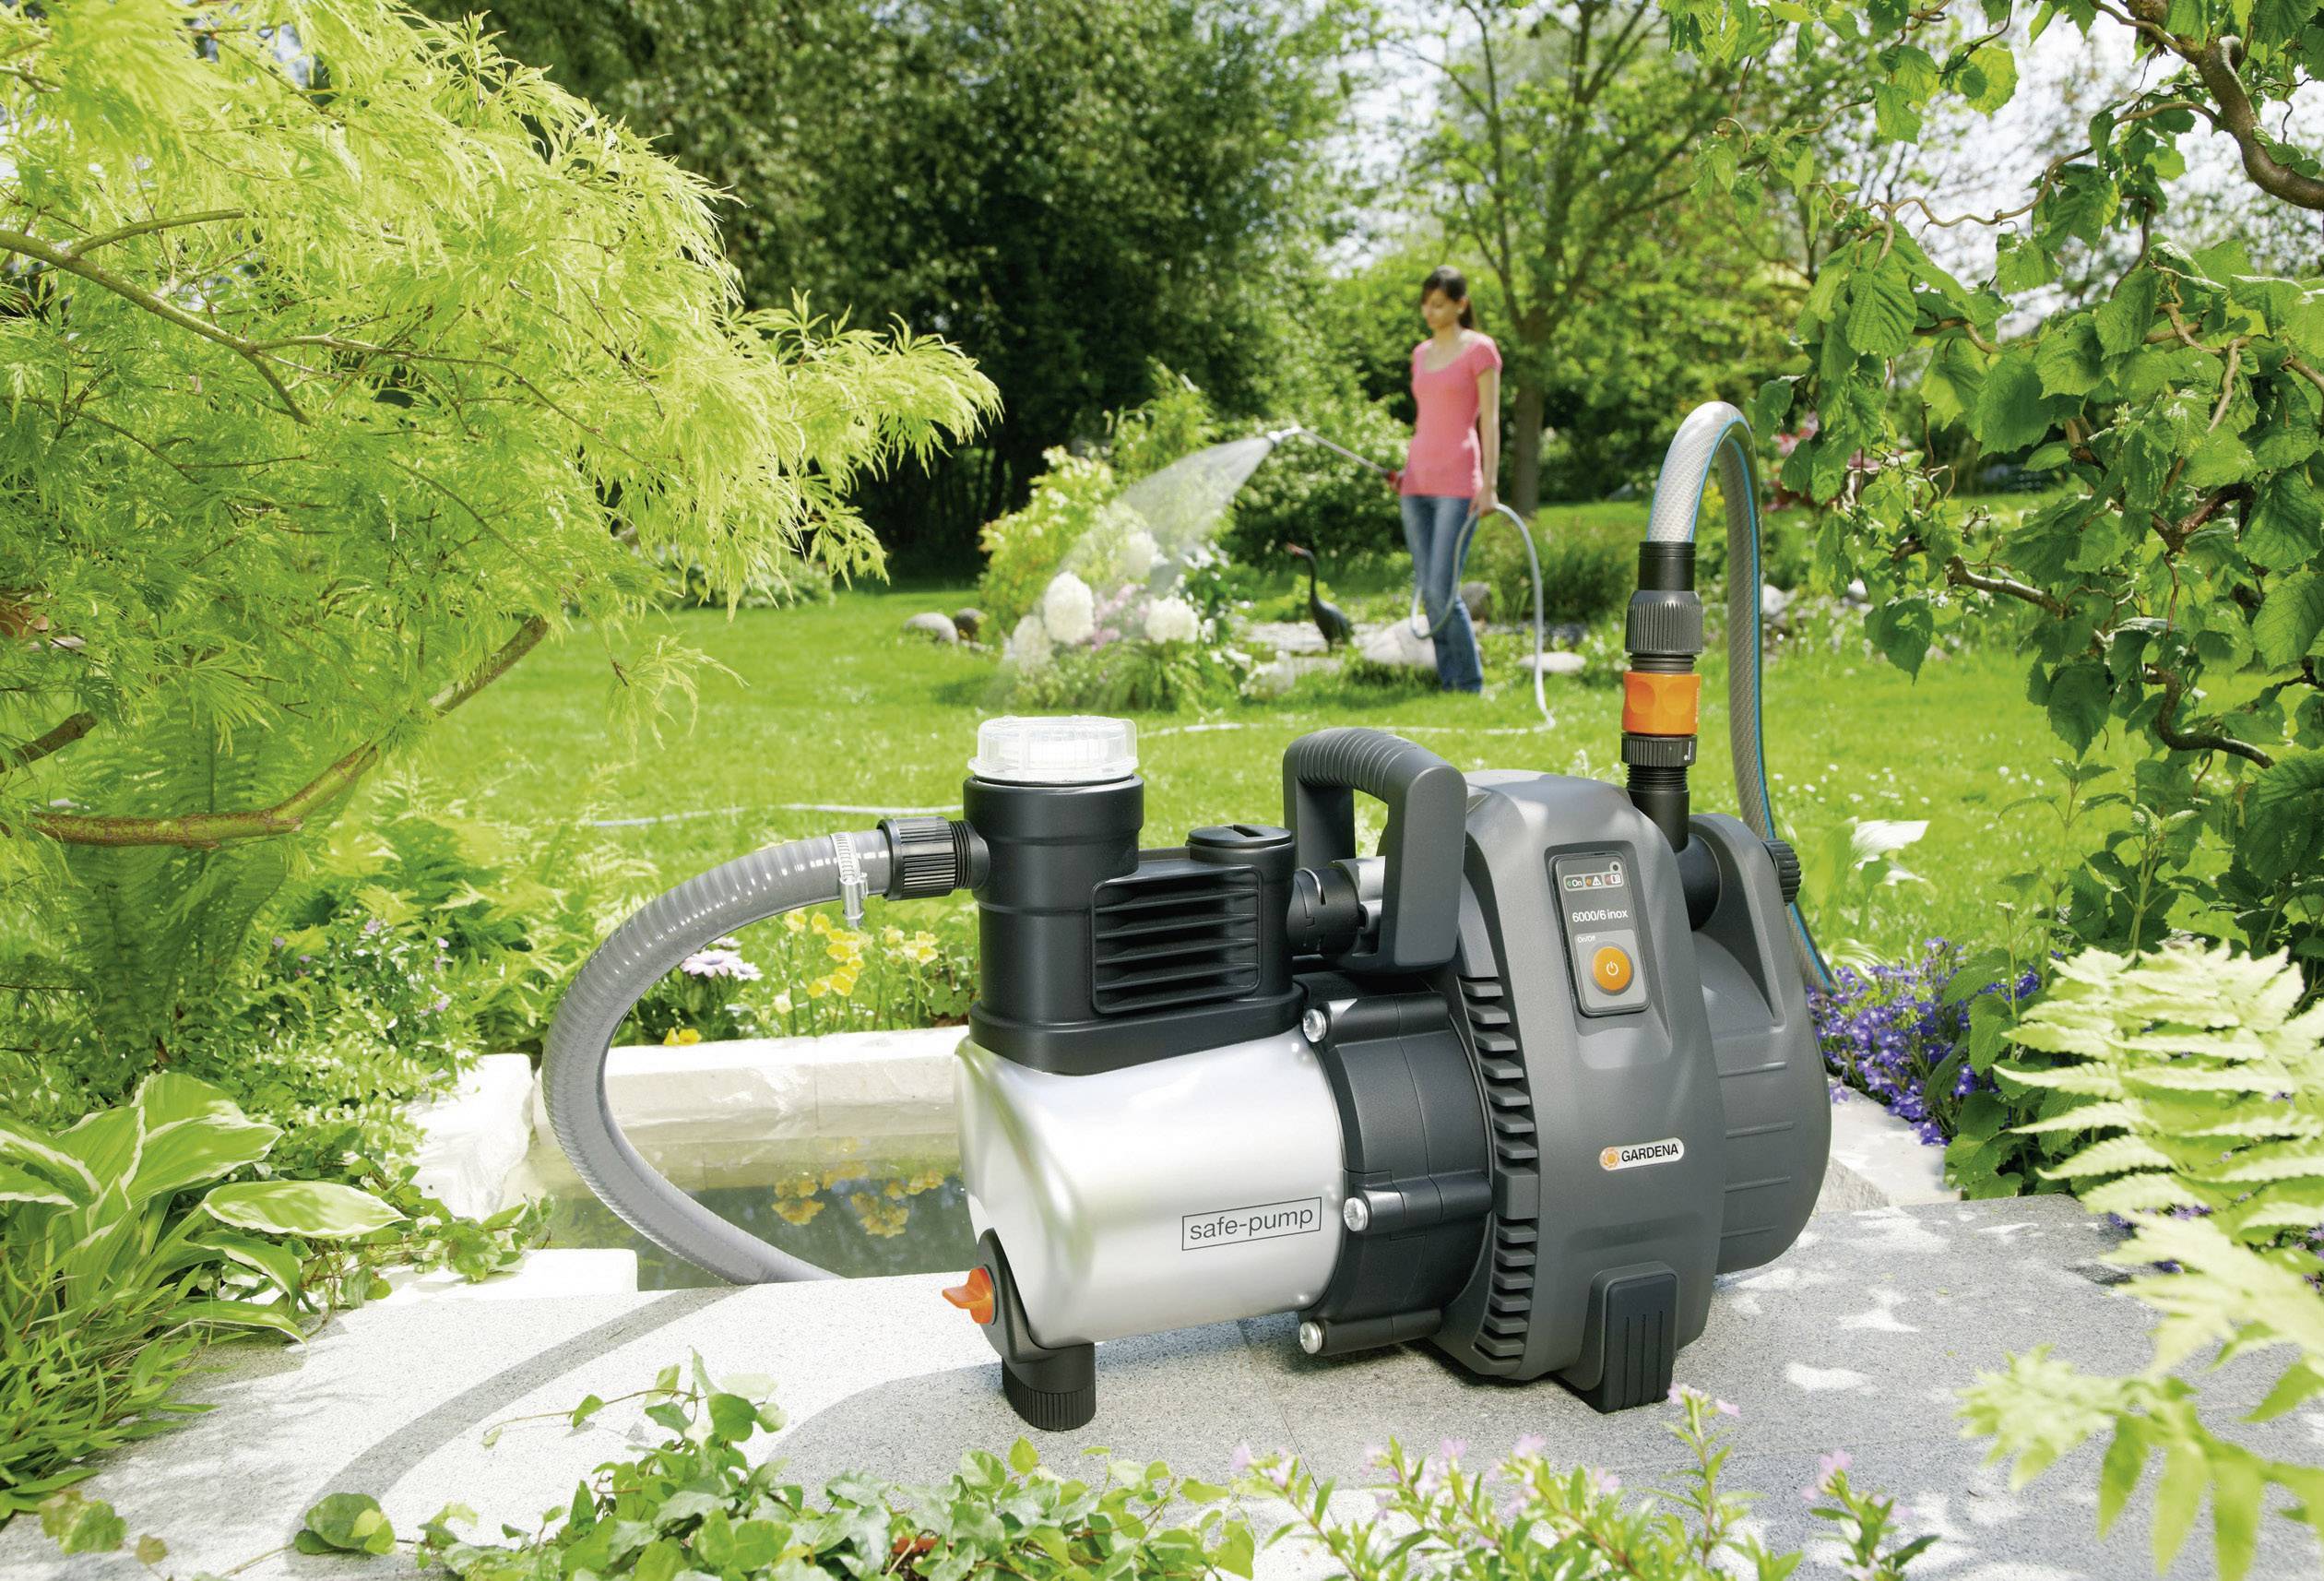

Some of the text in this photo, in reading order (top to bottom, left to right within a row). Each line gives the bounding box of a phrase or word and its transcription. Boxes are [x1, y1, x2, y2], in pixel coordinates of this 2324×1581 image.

[1571, 909, 1629, 922] 6000/6 inox
[1621, 1144, 1678, 1162] GARDENA
[1190, 1208, 1313, 1240] safe-pump
